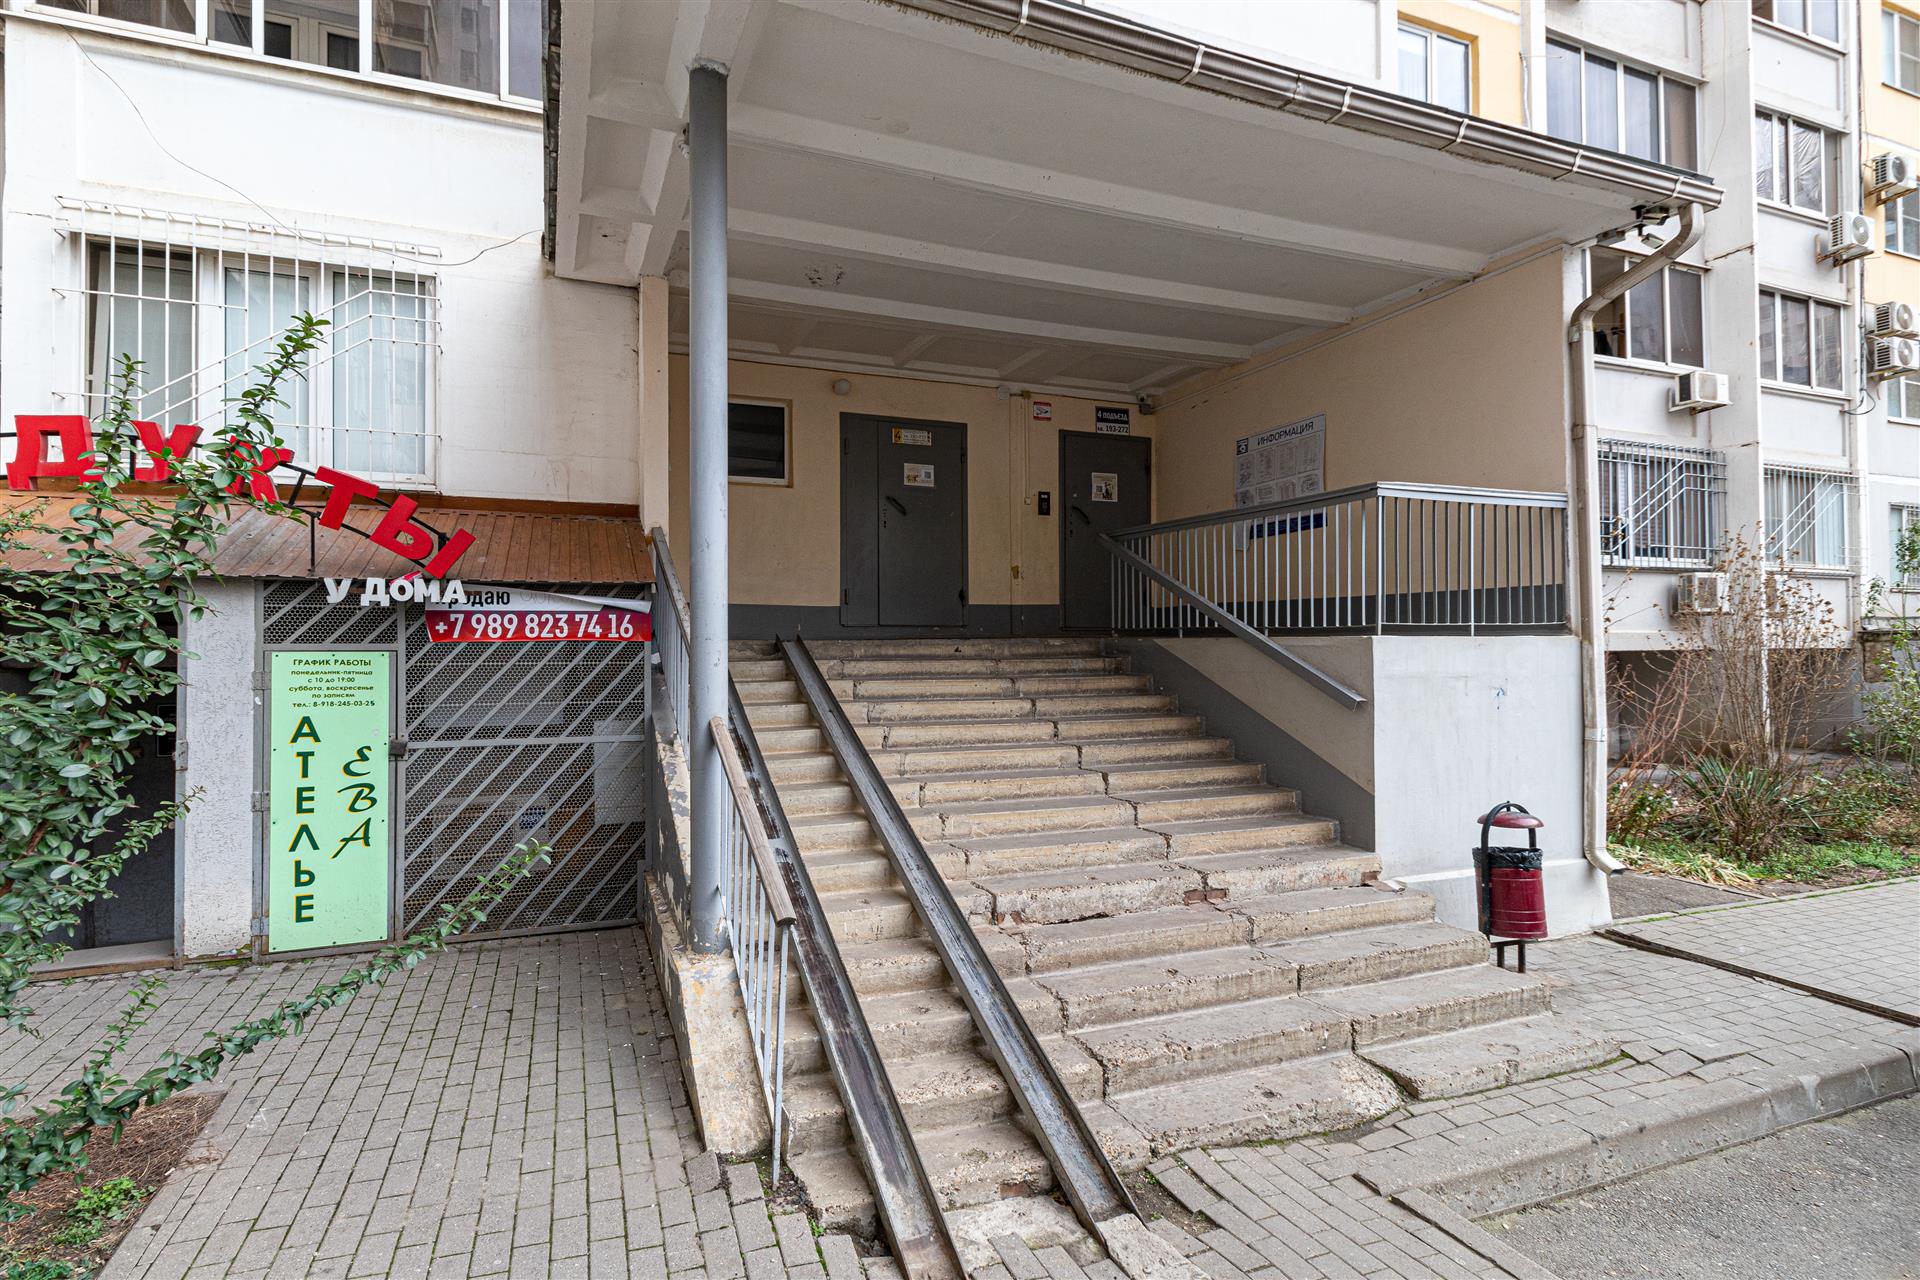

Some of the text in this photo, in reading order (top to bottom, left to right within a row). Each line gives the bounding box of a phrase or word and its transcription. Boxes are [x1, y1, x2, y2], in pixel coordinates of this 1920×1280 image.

[1097, 410, 1128, 421] 4 ПОДЪЕЗД
[1257, 421, 1314, 446] ИНФОРМАЦИЯ
[323, 577, 468, 606] У ДОМА
[435, 613, 634, 639] +7 989 823 74 16
[330, 745, 378, 860] ЕВА
[288, 715, 321, 924] АТЕЛЬЕ
